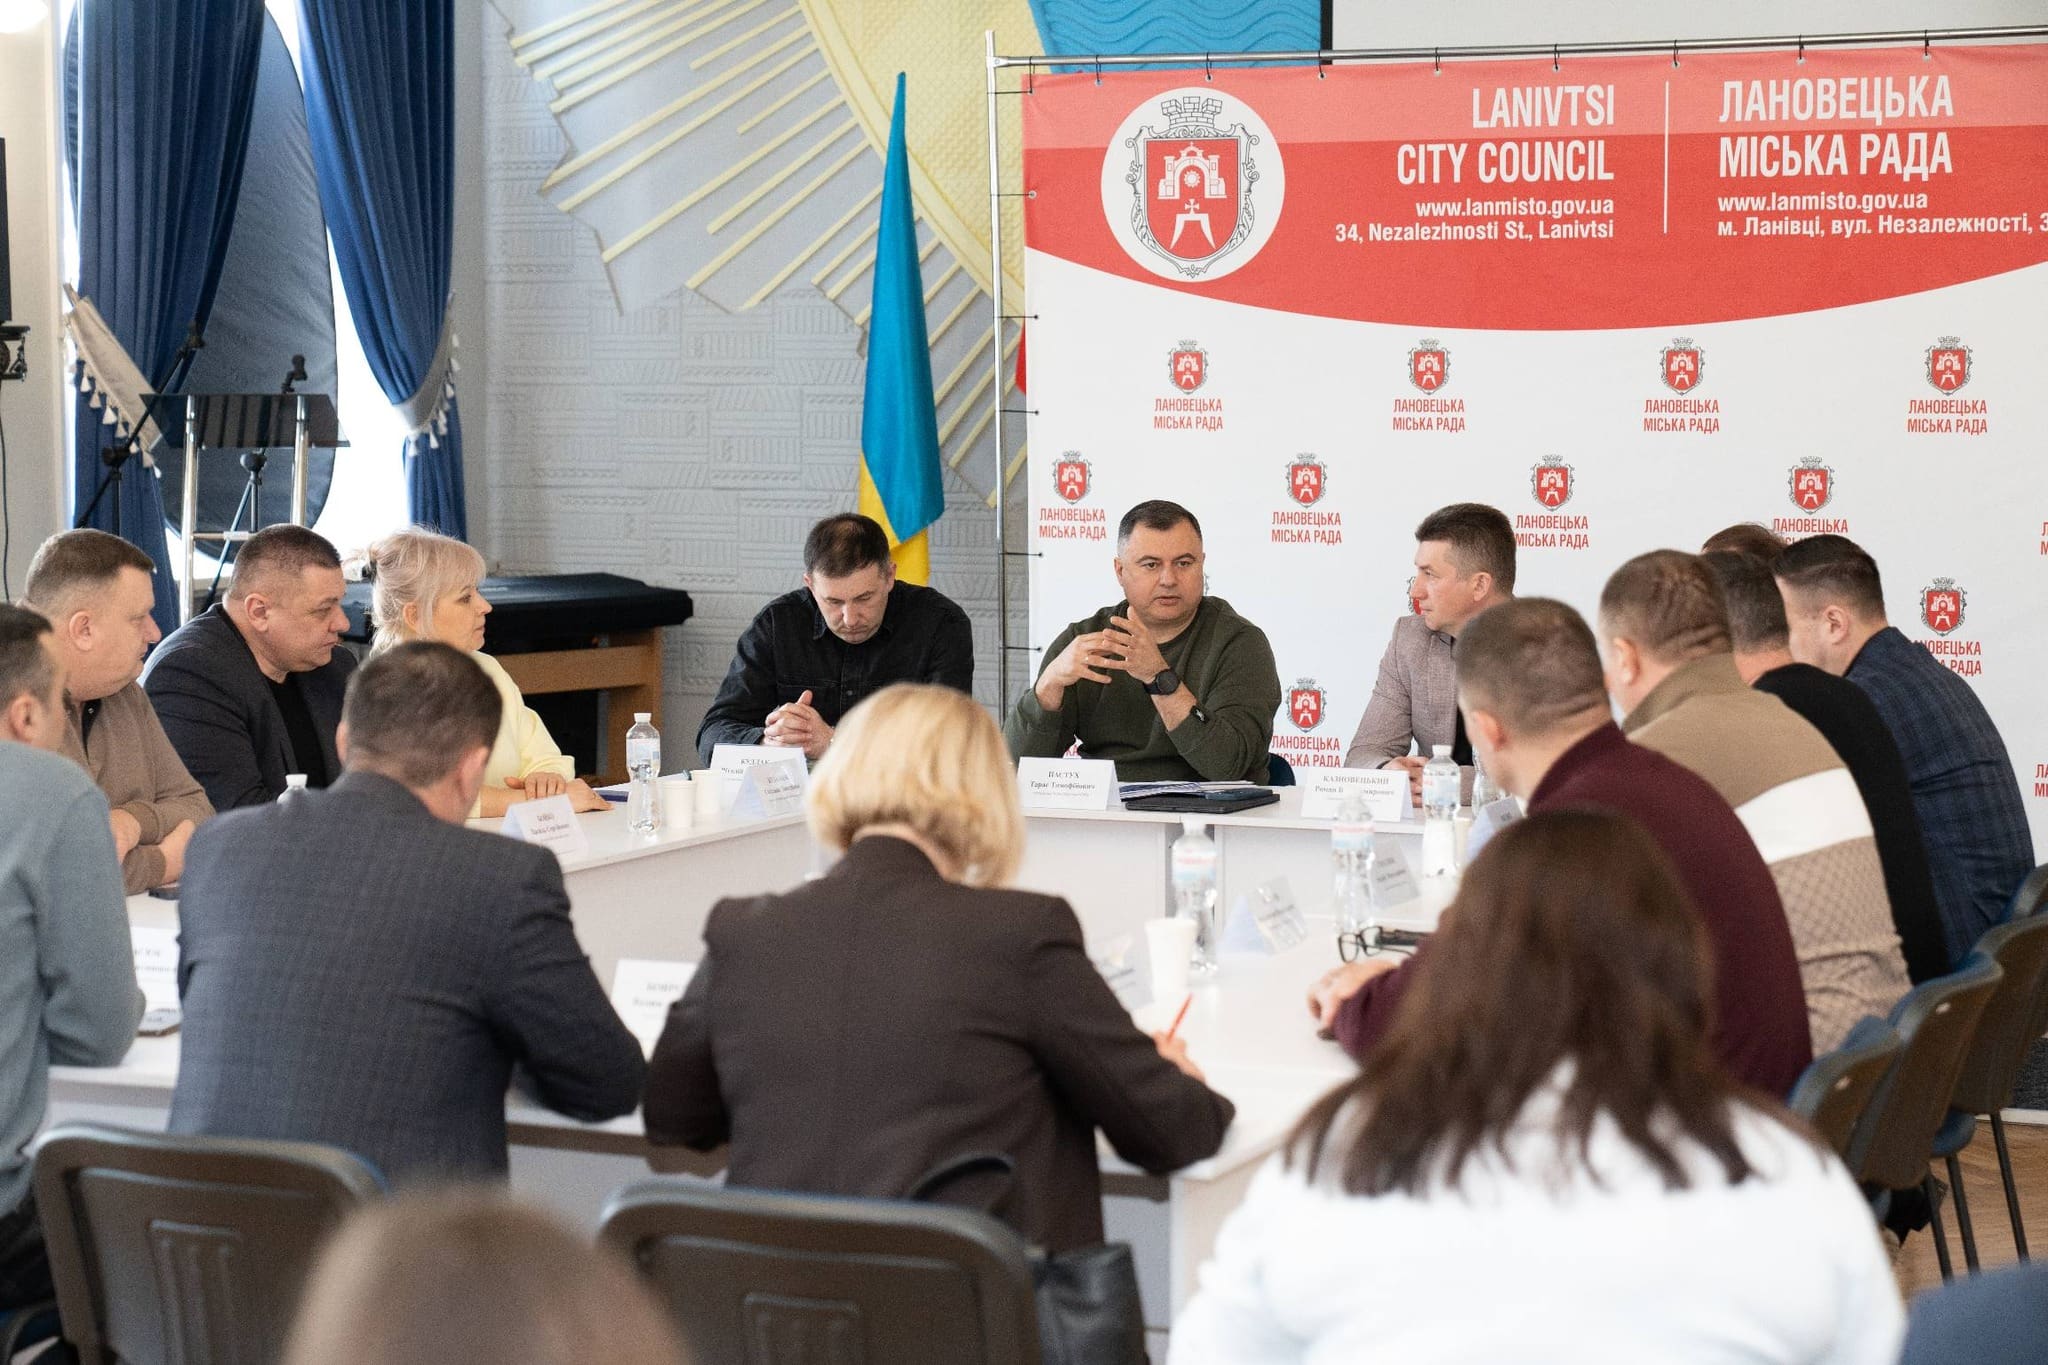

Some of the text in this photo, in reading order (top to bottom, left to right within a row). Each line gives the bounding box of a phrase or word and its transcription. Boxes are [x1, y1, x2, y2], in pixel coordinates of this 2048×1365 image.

[1472, 83, 1615, 129] LANIVTSI
[1718, 74, 1955, 126] ЛАНОВЕЦЬКА
[1397, 139, 1615, 185] CITY COUNCIL
[1719, 131, 1953, 182] МІСЬКА РАДА
[1415, 197, 1614, 219] www.lanmisto.gov.ua
[1717, 191, 1928, 214] www.lanmisto.gov.ua
[1335, 219, 1614, 244] 34, Nezalezhnosti St., Lanivtsi
[1718, 221, 1738, 236] м.
[1743, 215, 1825, 238] Ланівці,
[1831, 219, 1872, 239] вул.
[1878, 212, 2033, 234] Незалежності,
[1154, 398, 1222, 413] ЛАНОВЕЦЬКА
[1393, 398, 1465, 414] ЛАНОВЕЦЬКА
[1644, 399, 1720, 416] ЛАНОВЕЦЬКА
[1908, 399, 1987, 416] ЛАНОВЕЦЬКА
[1153, 416, 1223, 431] МІСЬКА РАДА
[1392, 416, 1465, 433] МІСЬКА РАДА
[1643, 417, 1720, 434] МІСЬКА РАДА
[1907, 418, 1987, 435] МІСЬКА РАДА
[1039, 507, 1106, 523] ЛАНОВЕЦЬКА
[1271, 511, 1342, 527] ЛАНОВЕЦЬКА
[1515, 514, 1589, 531] ЛАНОВЕЦЬКА
[1039, 524, 1107, 541] МІСЬКА РАДА
[1773, 518, 1849, 534] ЛАНОВЕЦЬКА
[1271, 529, 1342, 545] МІСЬКА РАДА
[1515, 533, 1589, 550] МІСЬКА РАДА
[1914, 640, 1982, 657] ОВЕЦЬКА
[1950, 660, 1982, 677] РАДА
[1271, 735, 1341, 752] ЛАНОВЕЦЬКА
[1313, 754, 1341, 768] РАДА
